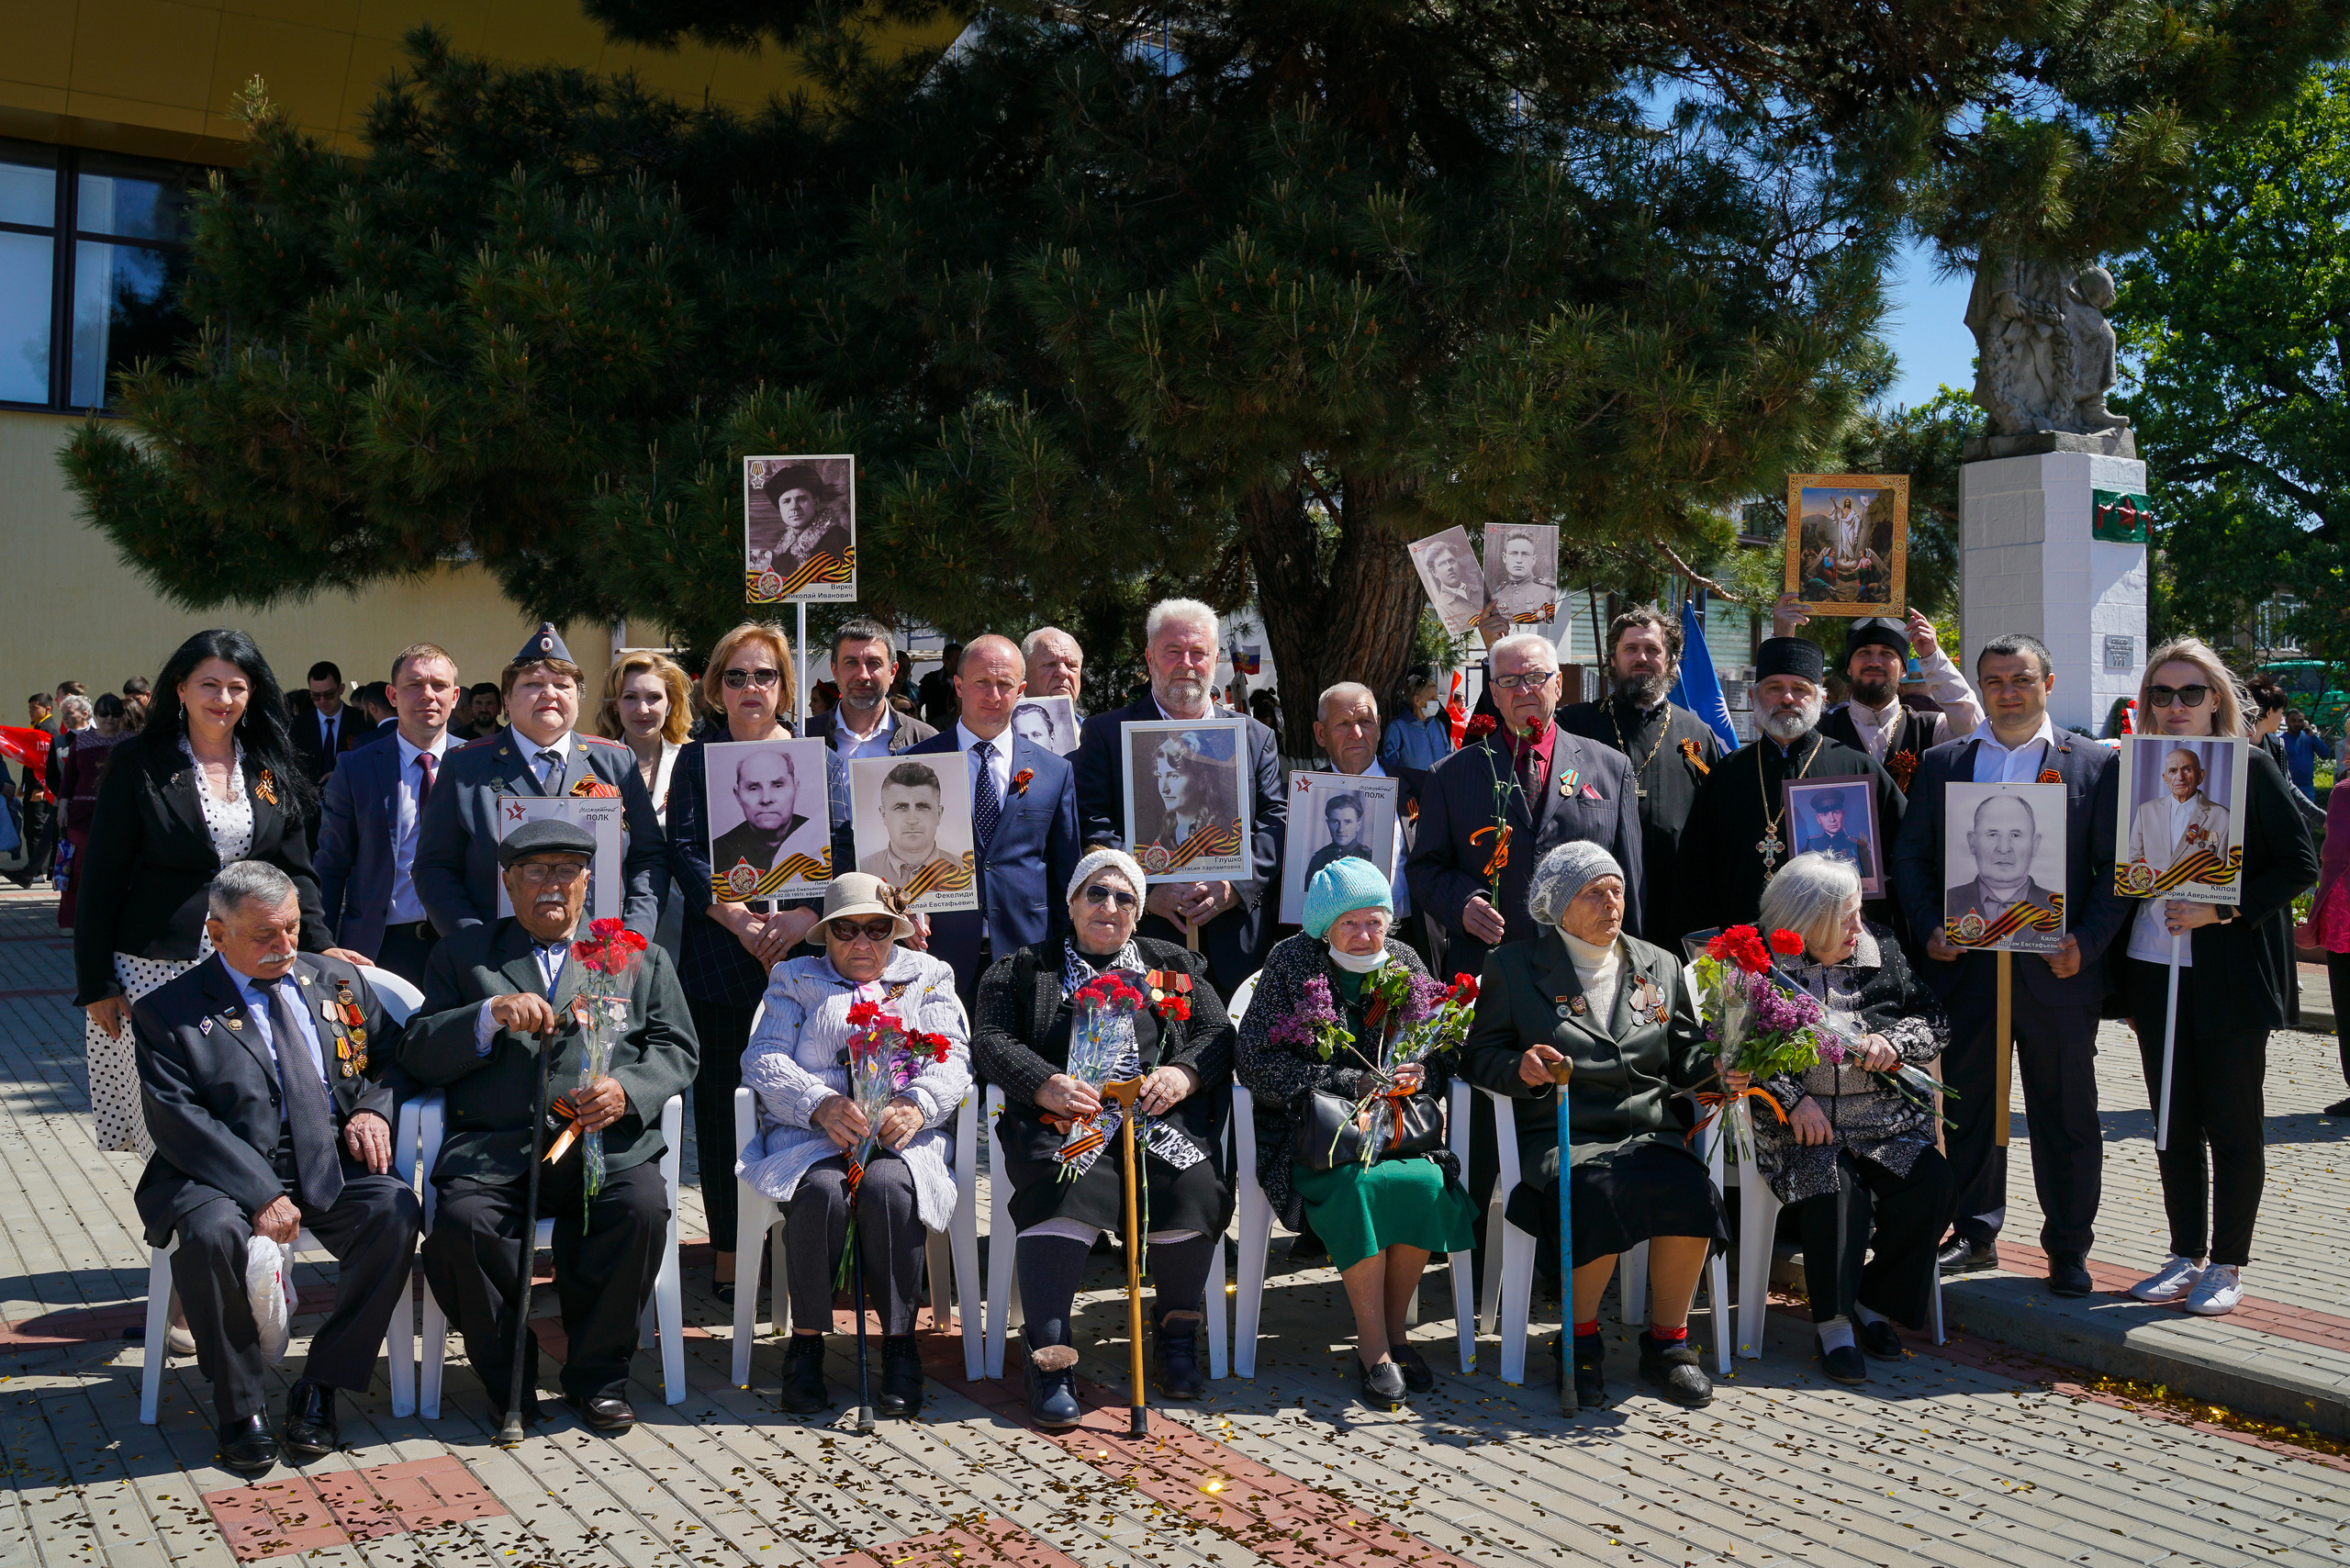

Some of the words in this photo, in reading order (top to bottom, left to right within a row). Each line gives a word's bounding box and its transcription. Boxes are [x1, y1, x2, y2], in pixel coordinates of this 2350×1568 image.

[1214, 857, 1242, 865] Глушко
[2210, 884, 2237, 892] Кялов
[2152, 889, 2186, 897] Григорий
[2187, 891, 2237, 901] Аверьянович
